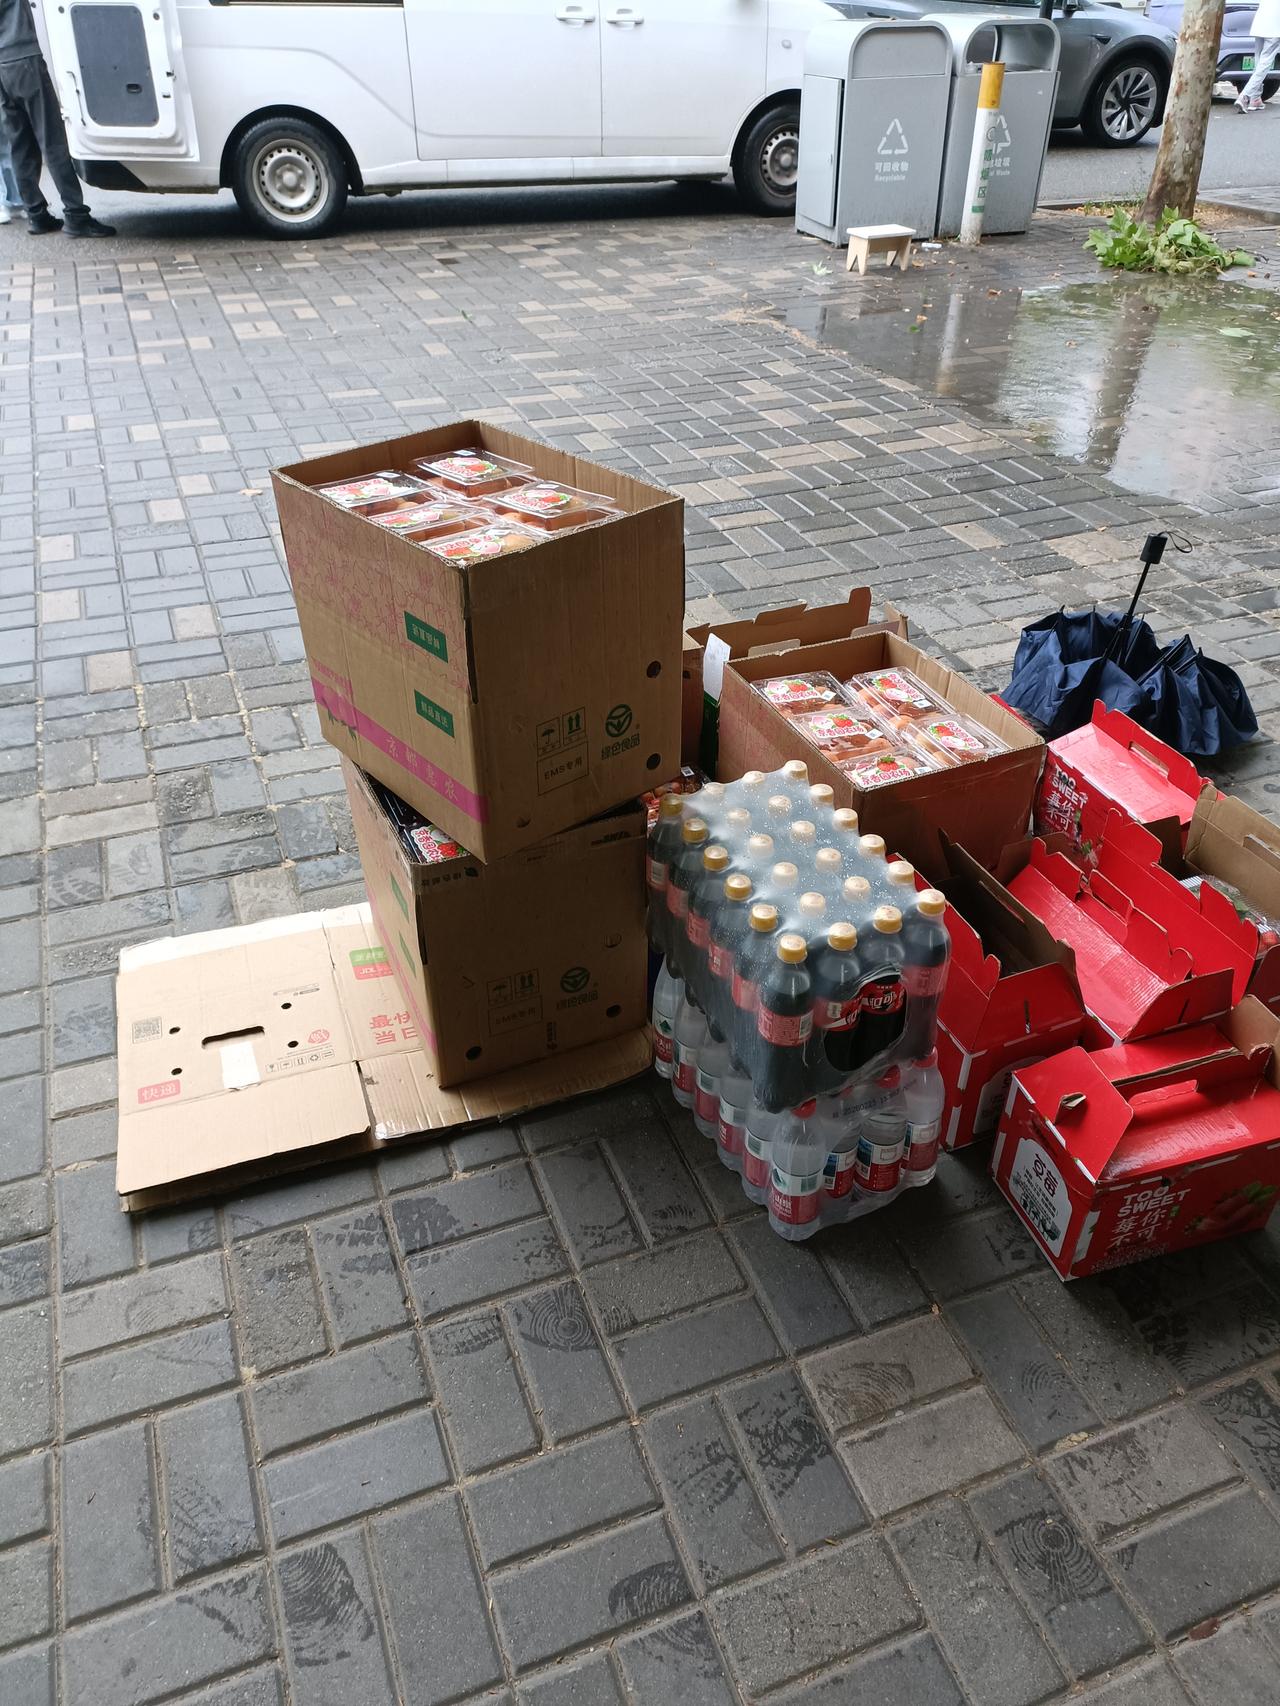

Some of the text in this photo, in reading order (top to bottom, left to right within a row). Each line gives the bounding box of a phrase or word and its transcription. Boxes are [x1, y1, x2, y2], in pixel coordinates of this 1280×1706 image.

[862, 768, 911, 786] 京香园农场
[1033, 1153, 1059, 1198] 草莓
[1117, 1188, 1192, 1218] SWEET
[1123, 1185, 1170, 1206] TOO
